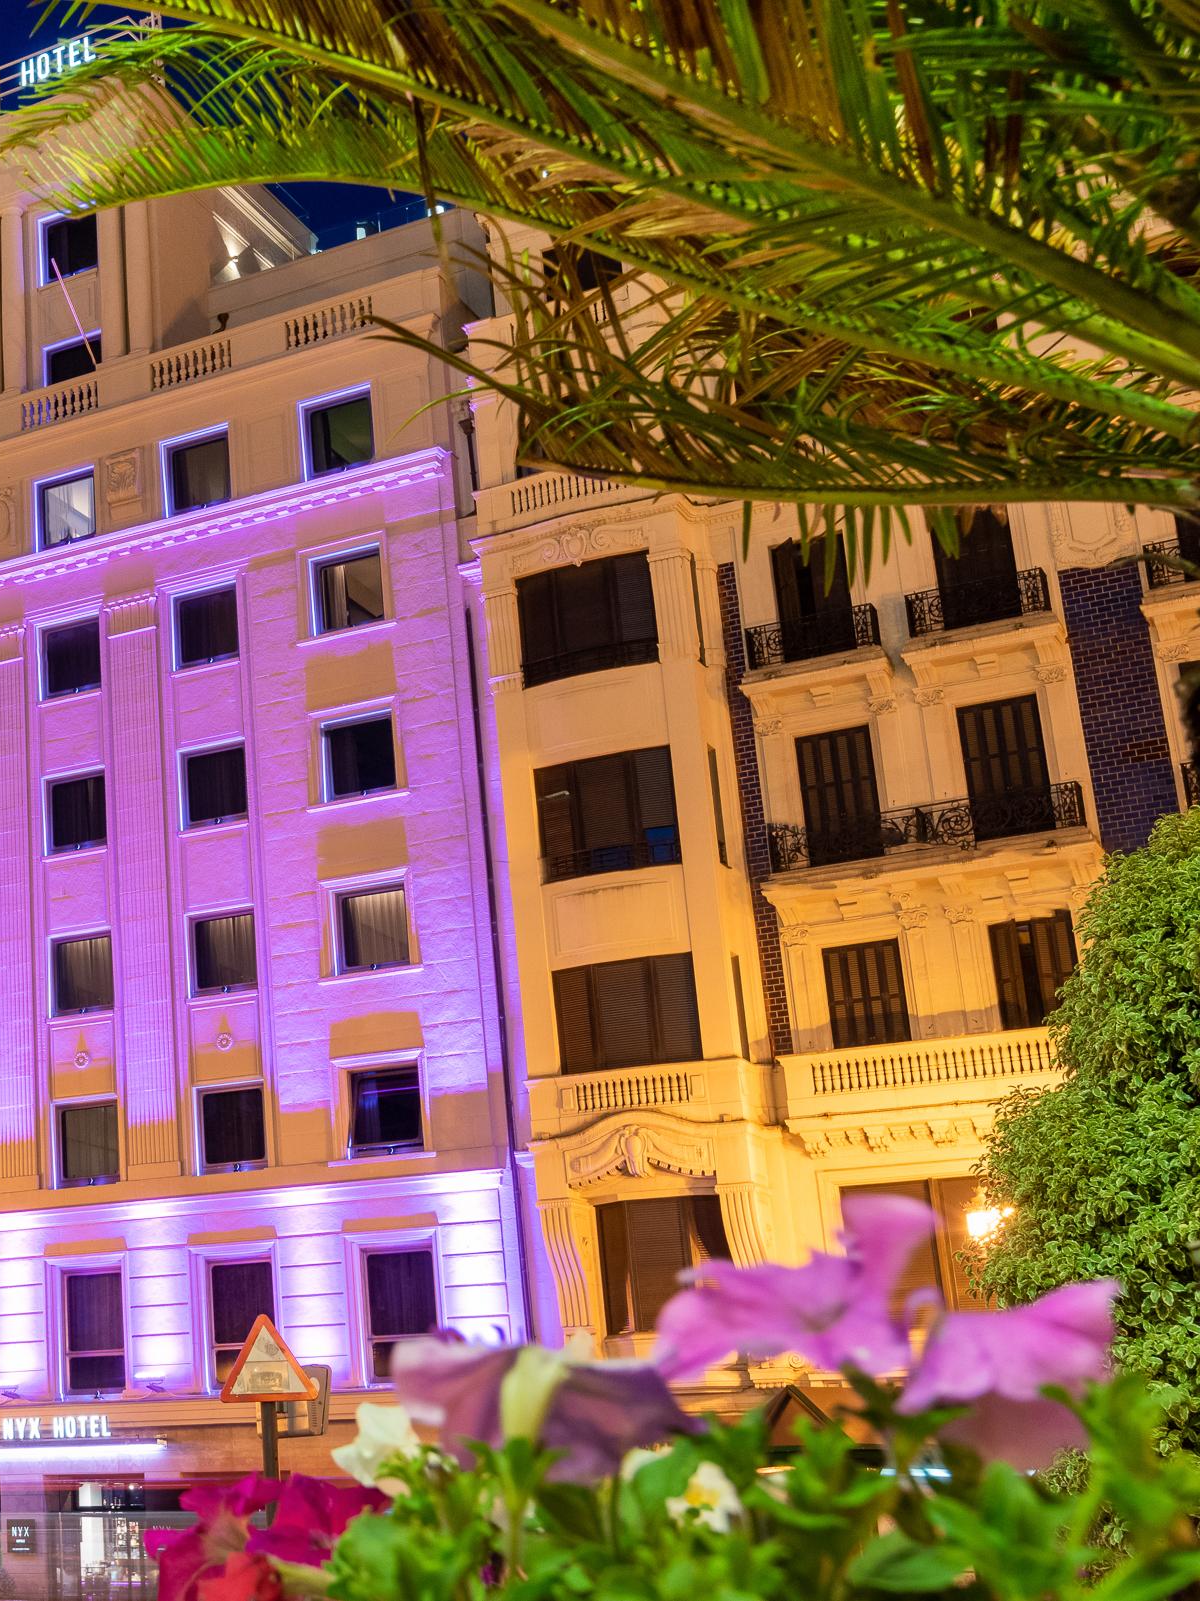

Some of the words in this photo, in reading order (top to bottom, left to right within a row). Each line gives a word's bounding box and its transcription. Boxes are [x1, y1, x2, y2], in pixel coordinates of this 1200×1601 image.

[21, 36, 96, 87] HOTEL
[2, 1417, 41, 1439] NYX
[53, 1415, 112, 1438] HOTEL
[11, 1526, 29, 1537] NYX
